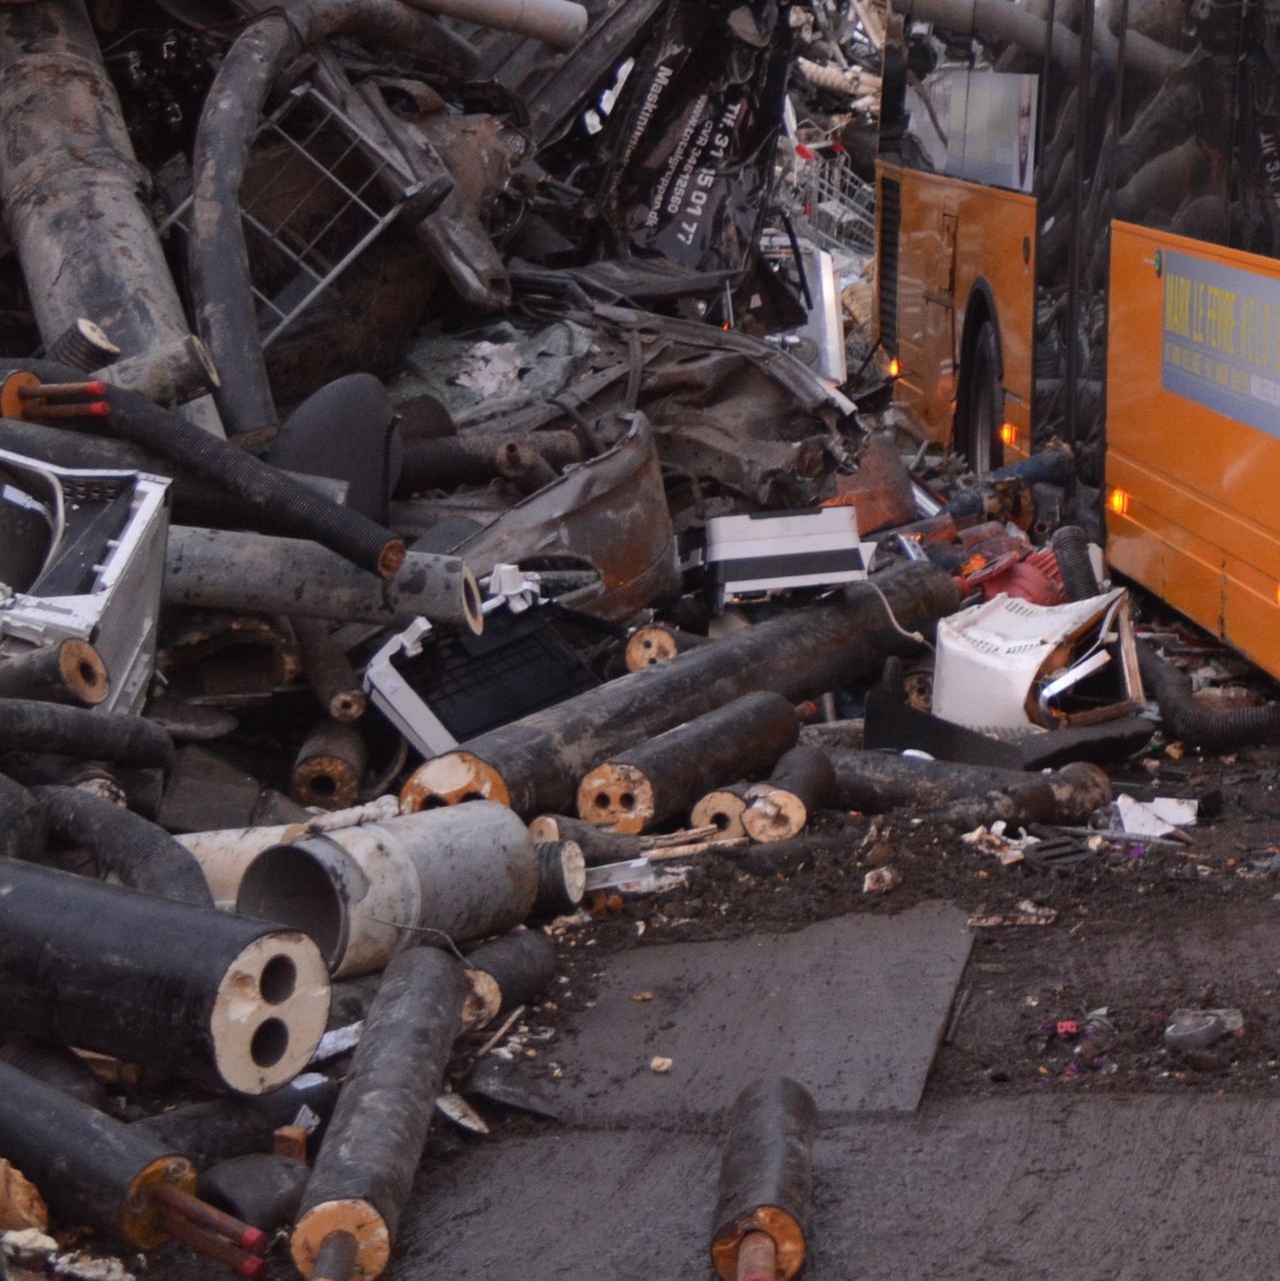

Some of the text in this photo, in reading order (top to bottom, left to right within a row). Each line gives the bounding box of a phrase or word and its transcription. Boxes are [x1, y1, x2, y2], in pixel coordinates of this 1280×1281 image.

[698, 120, 713, 146] CVR
[710, 133, 729, 158] 31
[697, 168, 716, 188] 15
[687, 191, 707, 216] 01
[677, 222, 698, 245] 77
